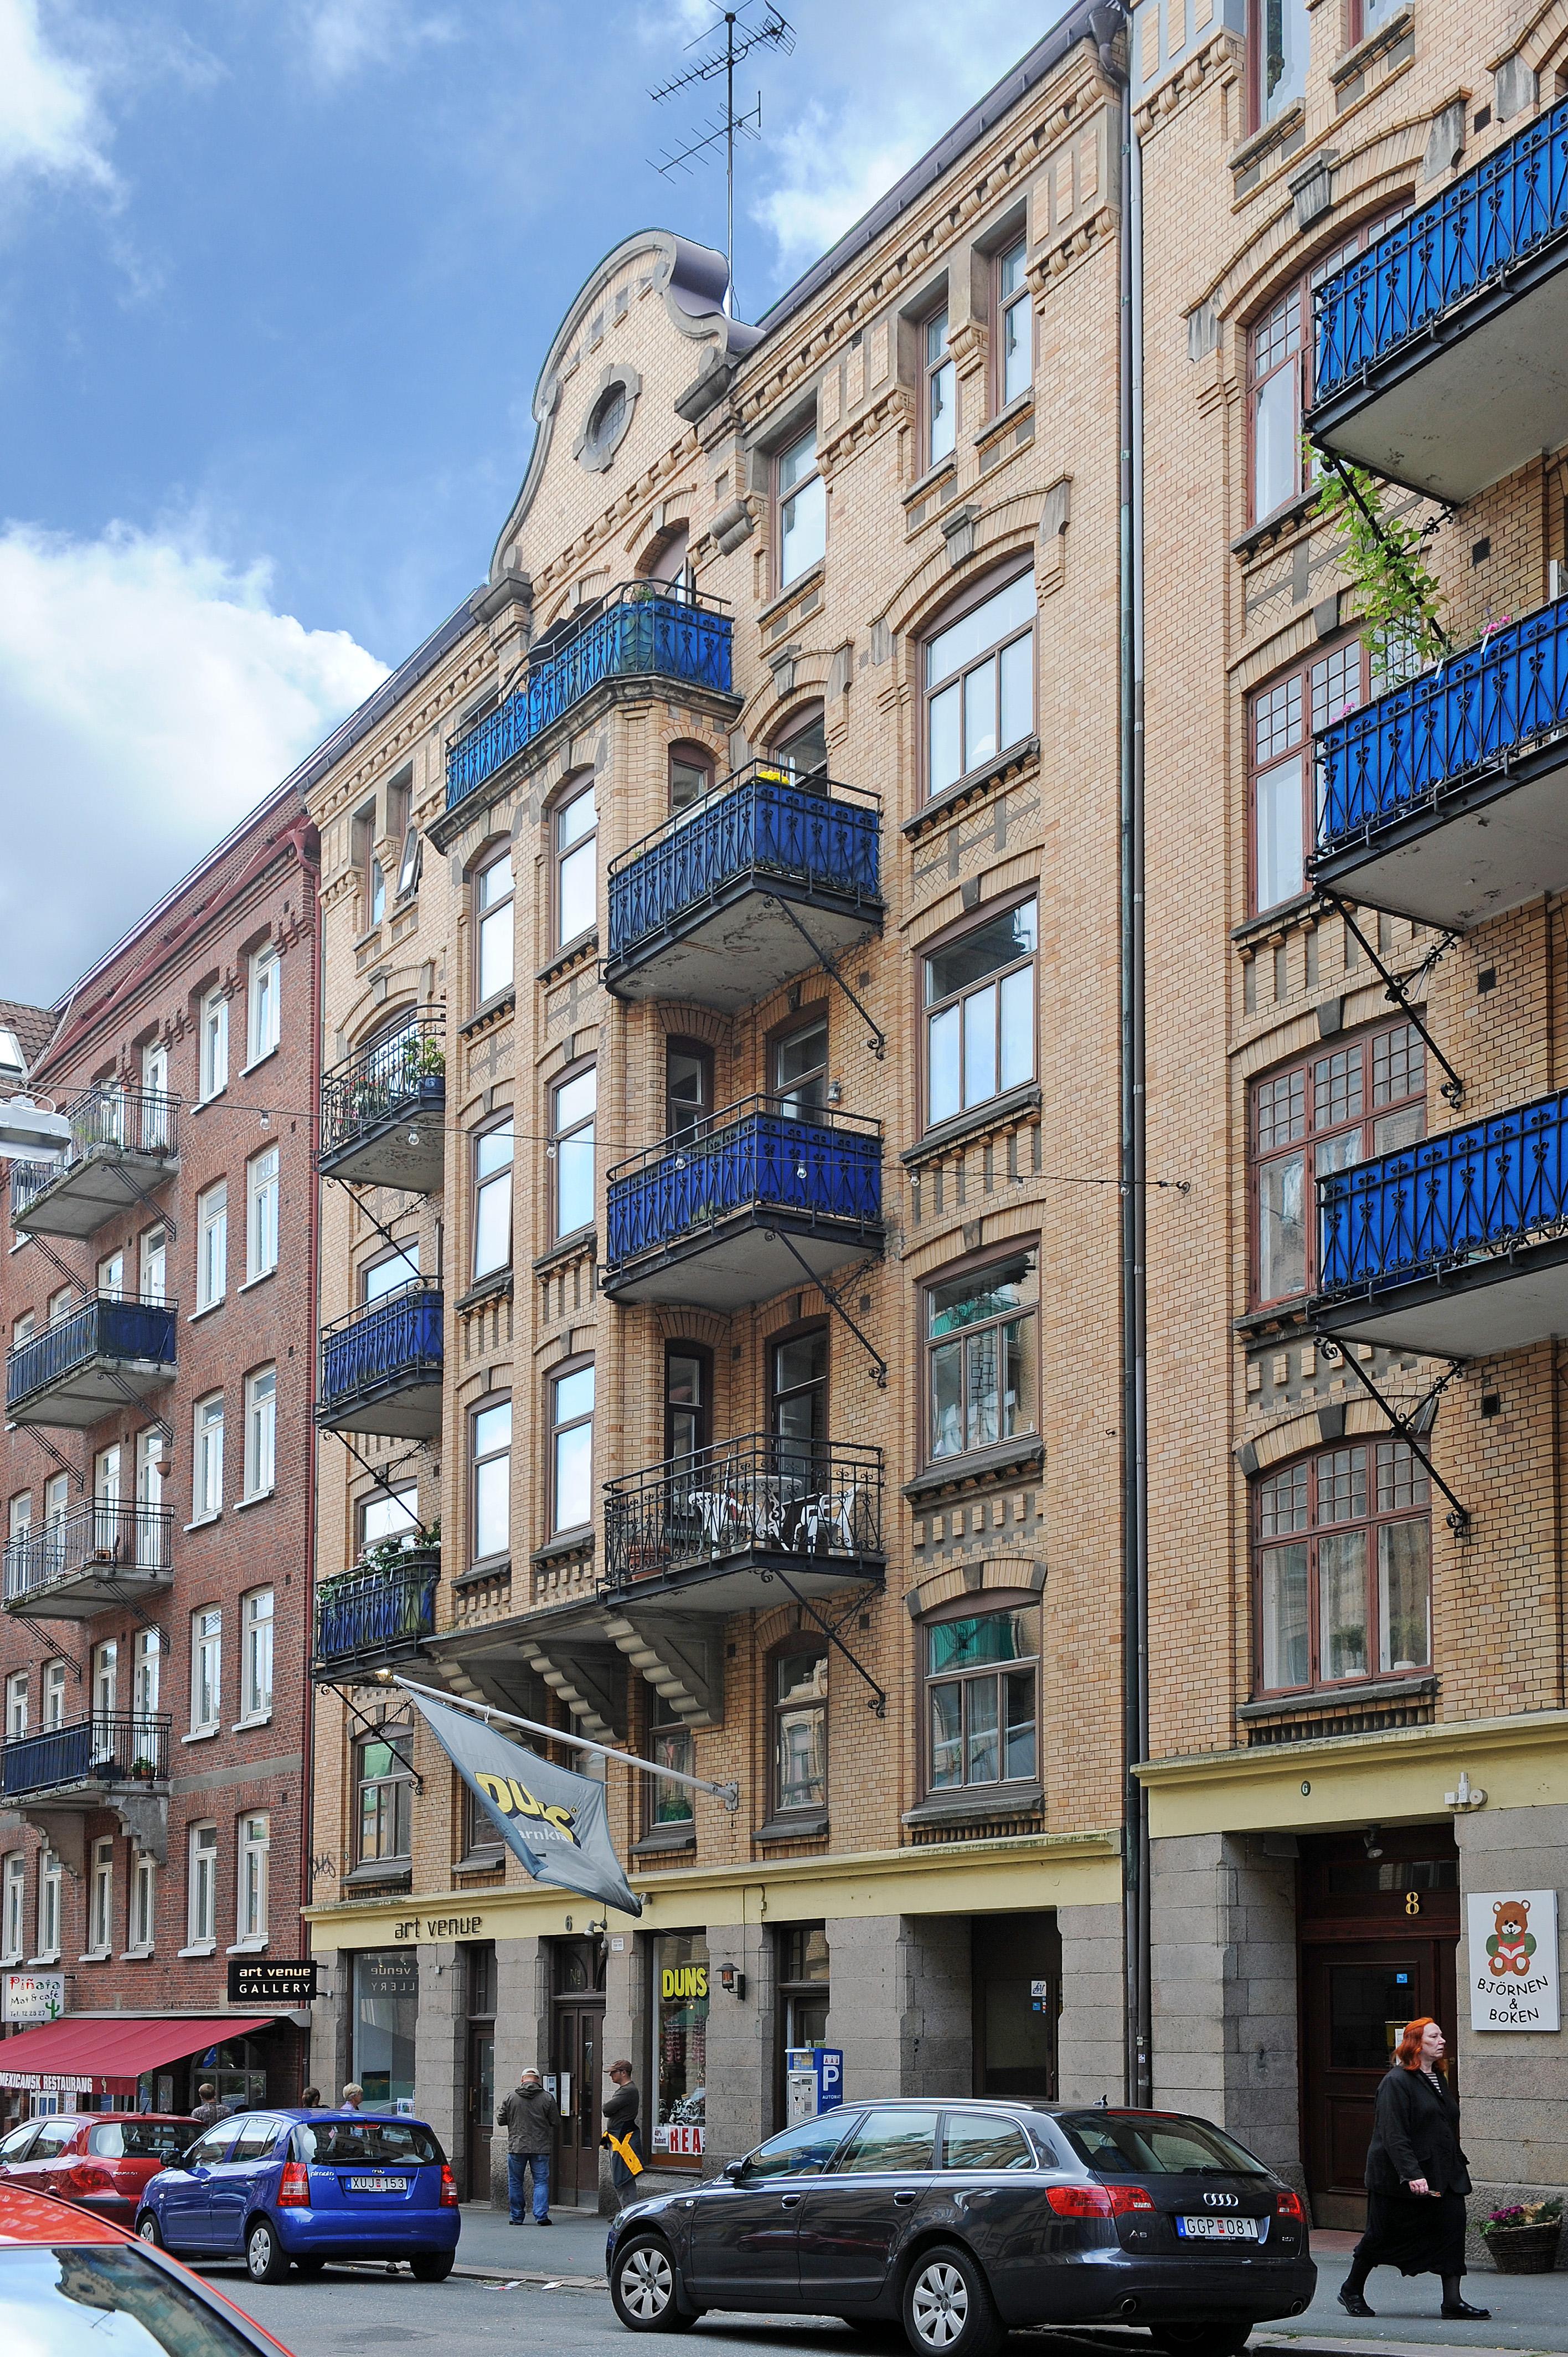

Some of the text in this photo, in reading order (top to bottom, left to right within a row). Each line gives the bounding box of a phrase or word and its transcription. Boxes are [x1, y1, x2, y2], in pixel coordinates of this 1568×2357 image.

[1302, 1784, 1308, 1793] G
[474, 1772, 579, 1846] DUS
[1406, 1892, 1419, 1915] 8
[395, 1917, 482, 1938] art venue
[566, 1915, 572, 1931] 6
[239, 1967, 311, 1977] art venue
[10, 1977, 60, 1990] Piñata
[239, 1984, 310, 1993] GALLERY
[662, 1967, 708, 2000] DUNS
[1478, 1975, 1548, 1995] BJÖRNEN
[11, 1996, 28, 2005] Mat
[39, 1990, 59, 2000] café
[1509, 1998, 1518, 2009] &
[1489, 2008, 1539, 2023] BOKEN
[0, 2072, 93, 2093] MEXICANSK RESTAURANG
[823, 2066, 839, 2091] P
[670, 2128, 702, 2153] REA
[353, 2178, 404, 2188] XUJ 153
[1187, 2219, 1214, 2234] GGP
[1226, 2220, 1253, 2235] 081
